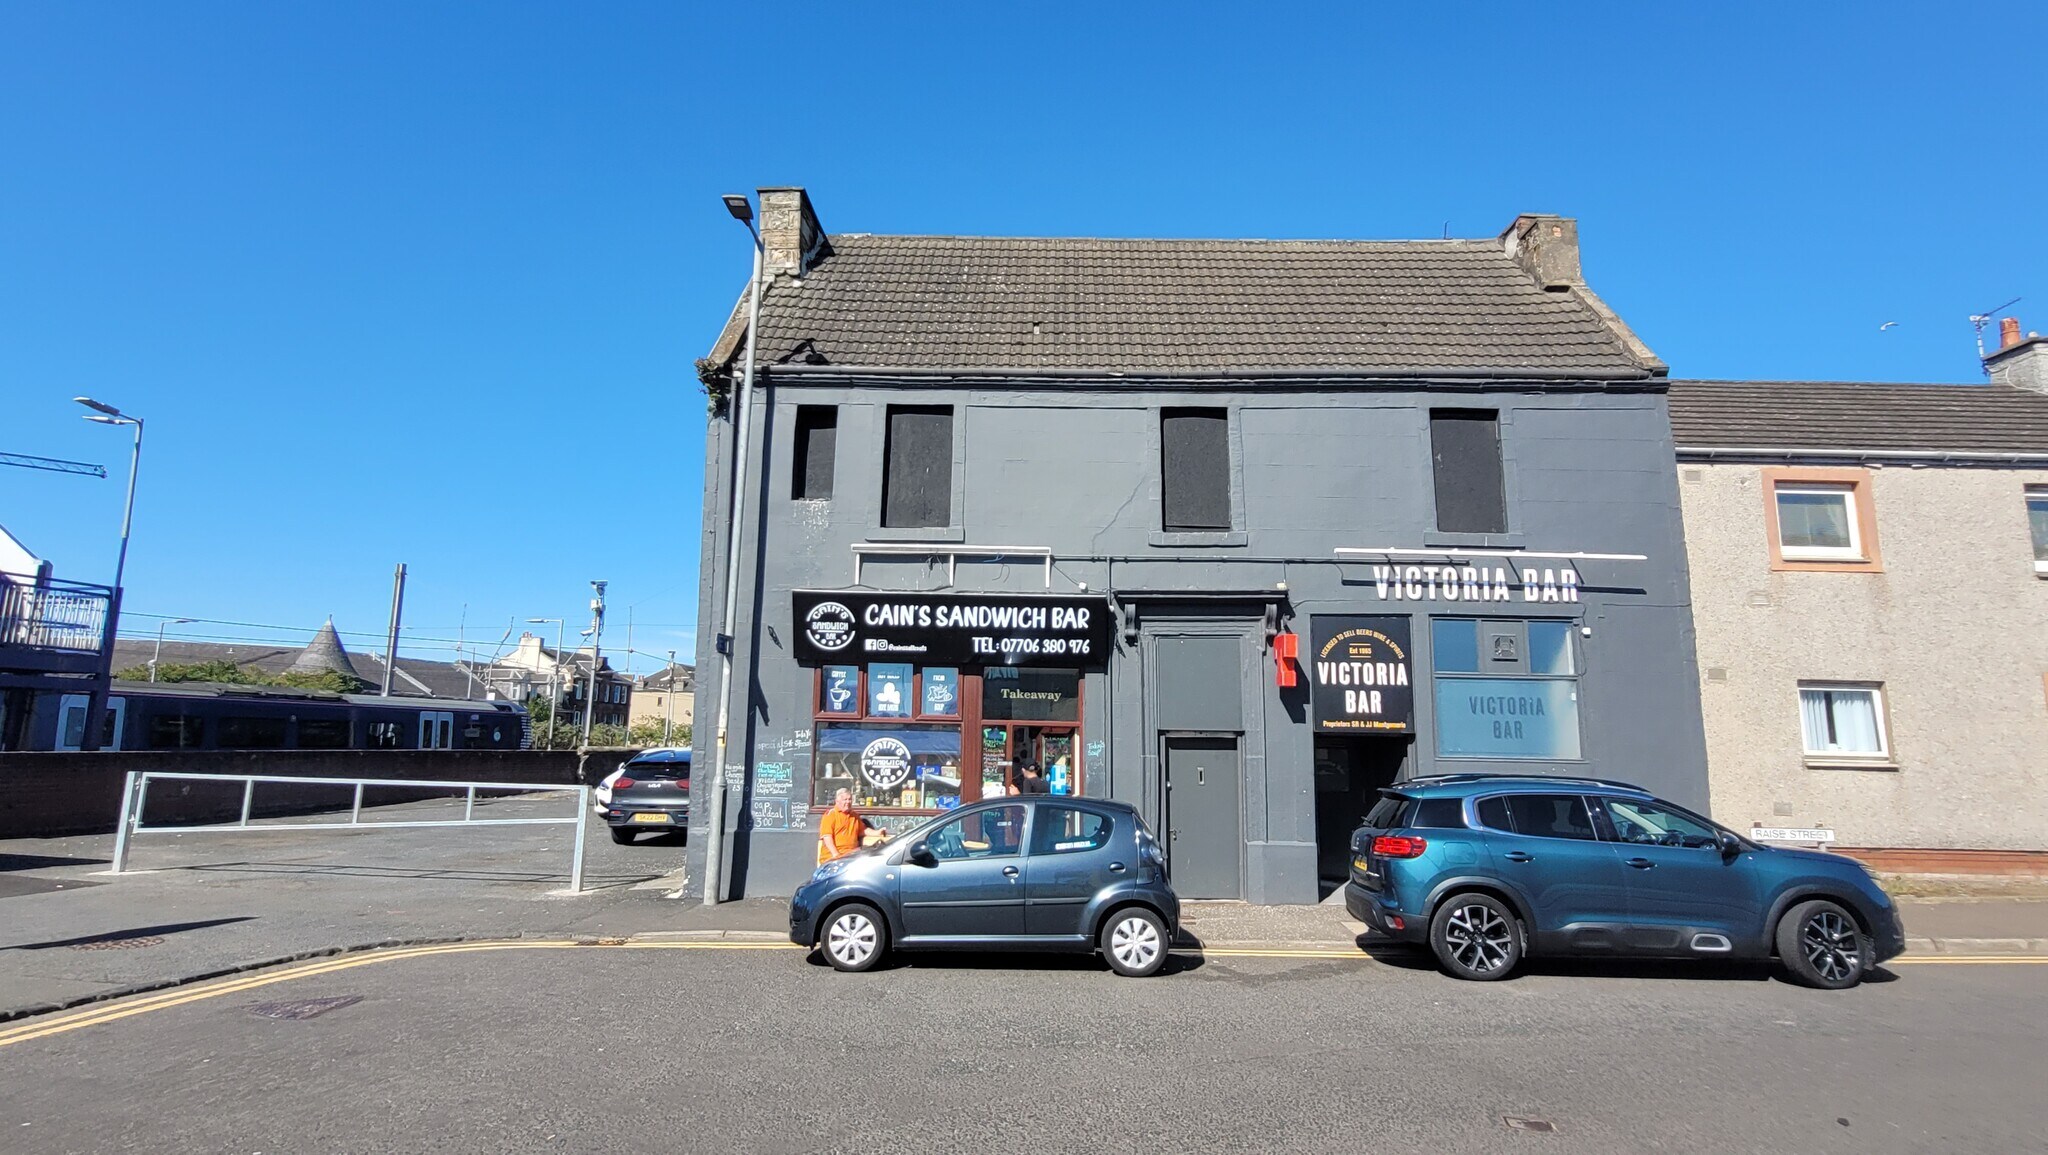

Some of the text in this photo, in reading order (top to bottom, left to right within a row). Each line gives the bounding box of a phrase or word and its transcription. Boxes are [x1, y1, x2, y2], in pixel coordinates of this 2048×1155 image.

[1373, 566, 1579, 602] VICTORIA BAR
[812, 621, 849, 631] SANDWICH
[865, 604, 1090, 629] CAIN'S SANDWICH BAR
[1343, 629, 1356, 638] SELL
[1356, 628, 1373, 636] BEERS
[972, 637, 1090, 654] TEL: 07706 380 976
[1317, 661, 1408, 685] VICTORIA
[1001, 688, 1062, 702] Takeaway
[1345, 689, 1382, 713] BAR
[1469, 696, 1545, 715] VICTORIA
[1493, 720, 1524, 739] BAR
[1755, 829, 1786, 838] RAISE
